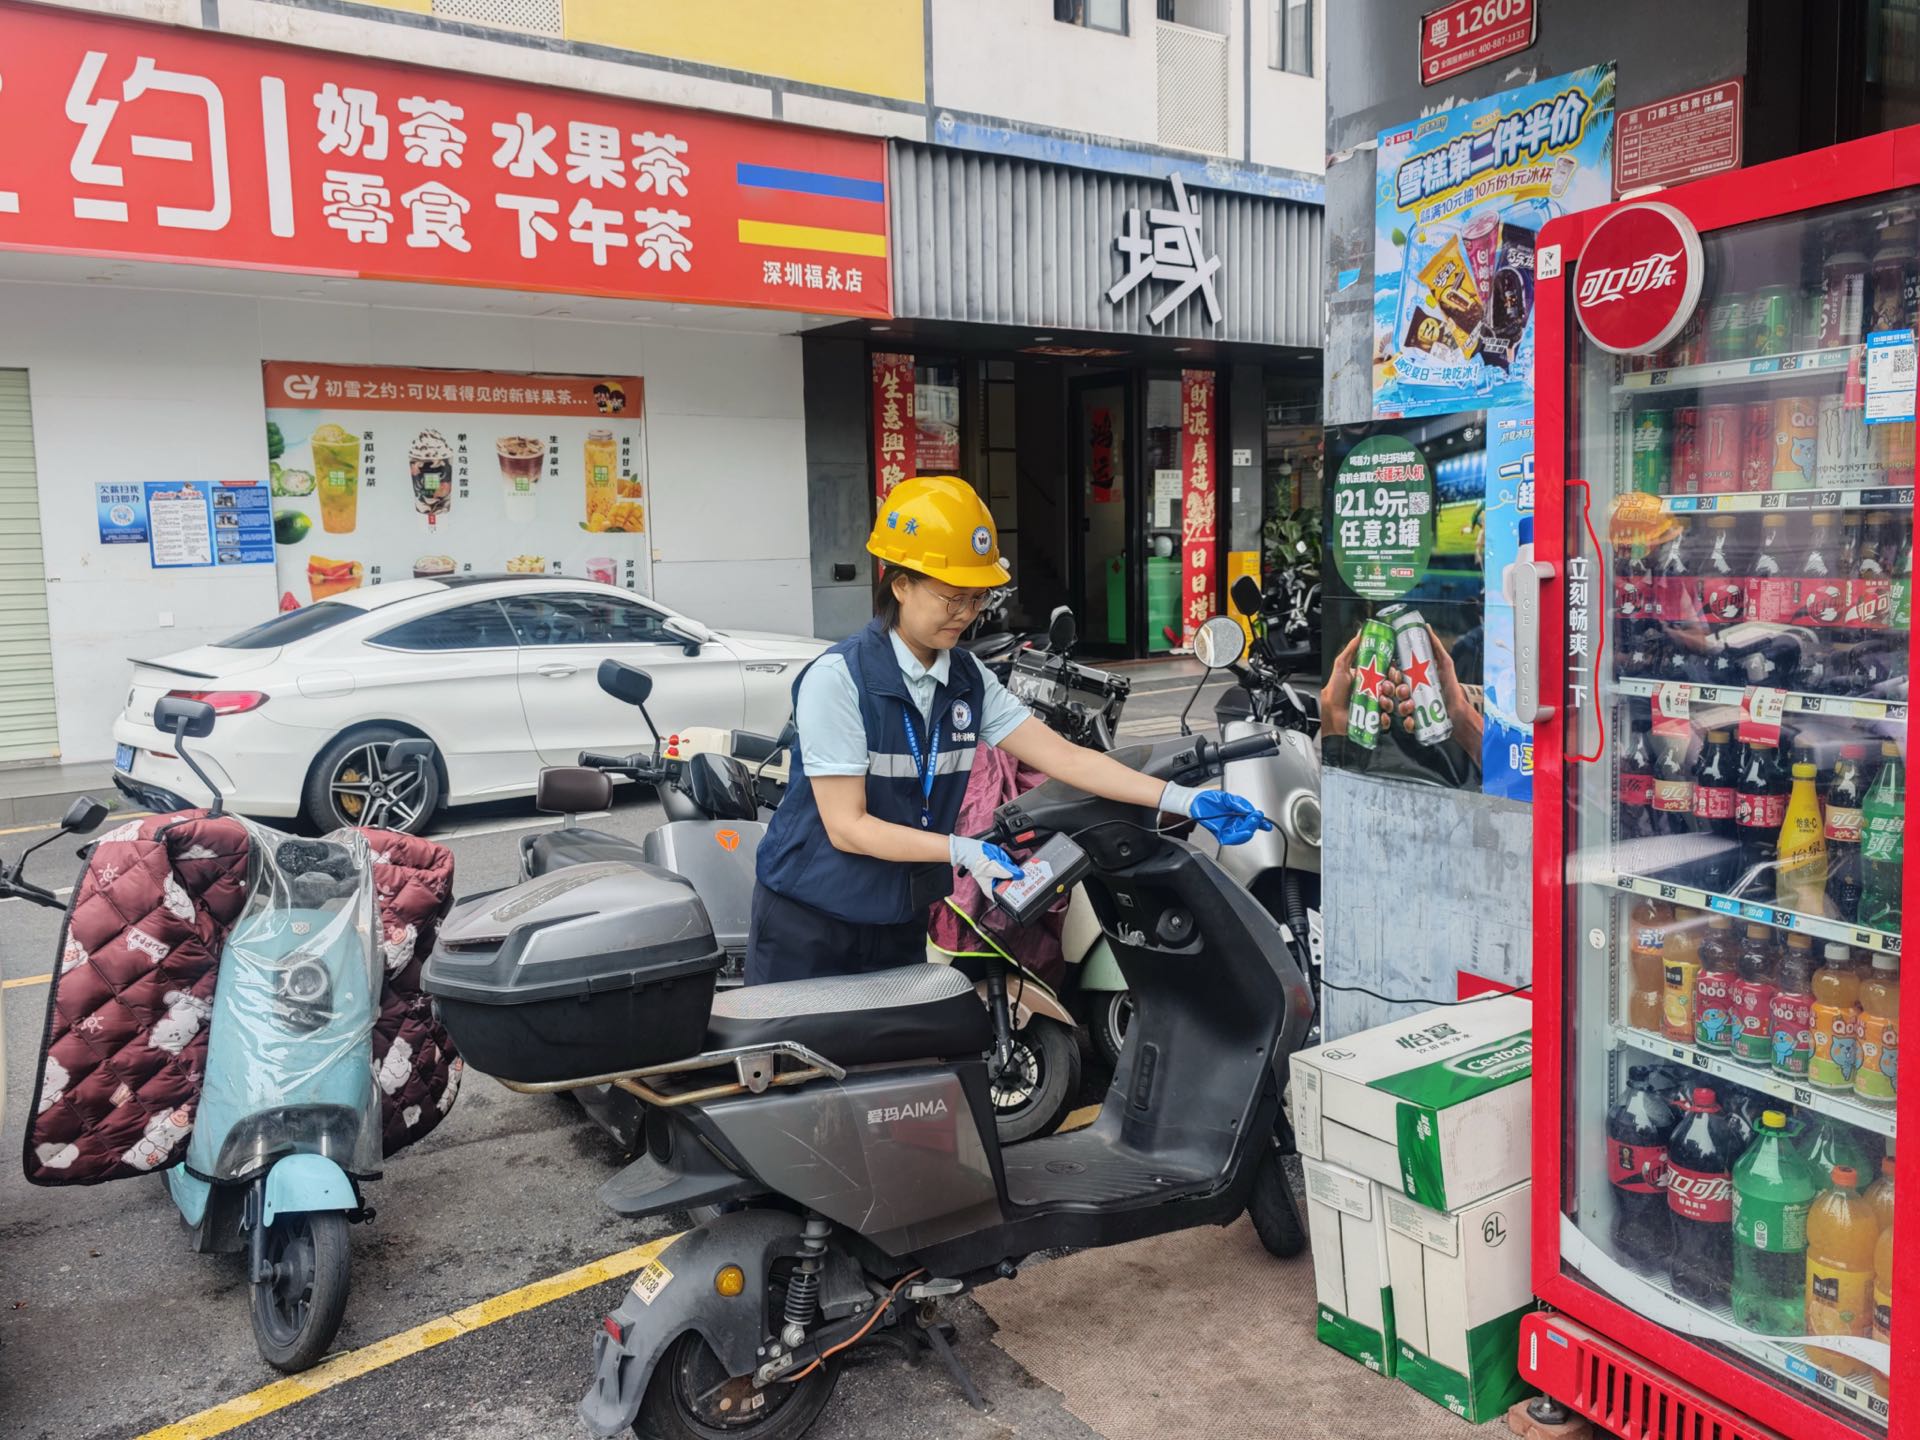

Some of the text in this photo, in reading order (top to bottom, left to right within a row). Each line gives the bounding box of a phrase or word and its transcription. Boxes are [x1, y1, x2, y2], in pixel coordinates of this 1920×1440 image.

[1430, 18, 1450, 48] 粤
[313, 81, 691, 198] 奶茶 水果茶
[1398, 89, 1588, 207] 雪糕第二件半价
[322, 169, 694, 273] 零食 下午茶
[1107, 171, 1222, 326] 域
[762, 260, 863, 293] 深圳福永店
[1580, 248, 1684, 308] 可口可乐
[1341, 487, 1409, 518] 21.9元
[886, 511, 919, 536] 福永
[1340, 518, 1421, 548] 任意3罐
[1568, 556, 1589, 708] 立刻畅爽一下
[1698, 981, 1727, 998] Qoo
[1466, 1039, 1532, 1072] C'estbon
[1482, 1216, 1506, 1245] 6L
